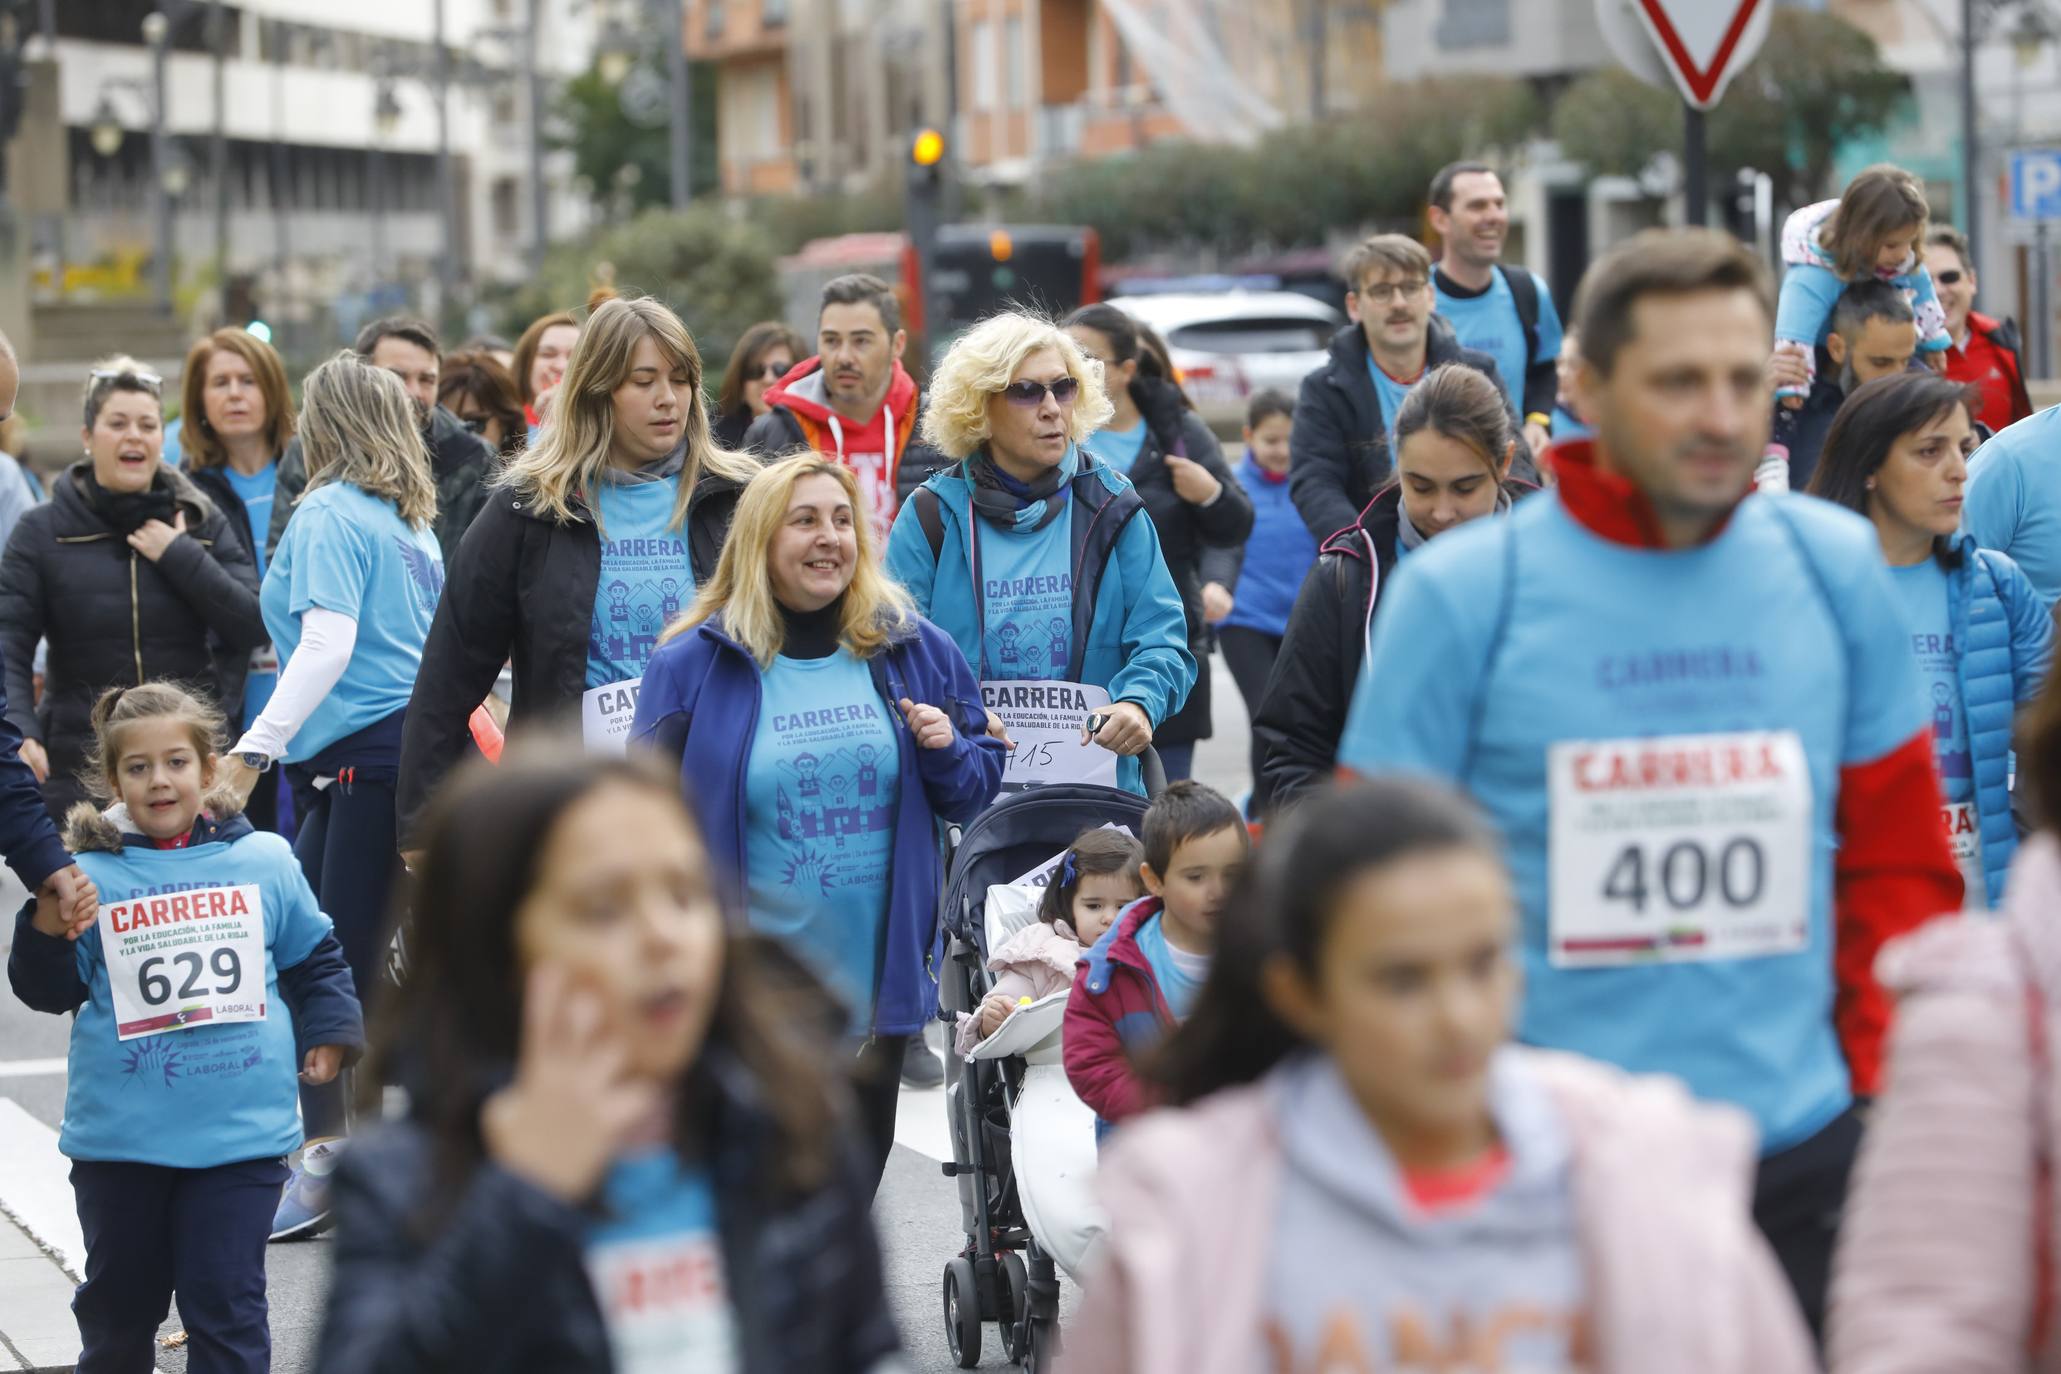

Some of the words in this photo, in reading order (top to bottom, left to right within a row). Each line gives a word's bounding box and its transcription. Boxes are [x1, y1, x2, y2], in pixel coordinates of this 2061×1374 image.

[2022, 160, 2061, 208] P
[986, 573, 1072, 598] CARRERA
[981, 686, 1088, 711] CARRERA
[610, 717, 623, 725] POR
[772, 704, 879, 732] CARRERA
[1013, 711, 1050, 720] EDUCACIÓN,
[1016, 721, 1051, 729] SALUDABLE
[1604, 836, 1767, 914] 400
[111, 890, 249, 933] CARRERA
[123, 936, 139, 945] POR
[141, 933, 150, 942] LA
[152, 926, 198, 940] EDUCACIÓN,
[200, 925, 210, 933] LA
[212, 921, 242, 930] FAMILIA
[126, 946, 136, 955] LA
[138, 943, 156, 952] VIDA
[158, 936, 202, 949] SALUDABLE
[204, 934, 214, 942] DE
[216, 932, 226, 941] LA
[227, 931, 248, 939] RIOJA
[138, 947, 242, 1005] 629
[216, 1004, 255, 1014] LABORAL
[187, 1061, 240, 1076] LABORAL
